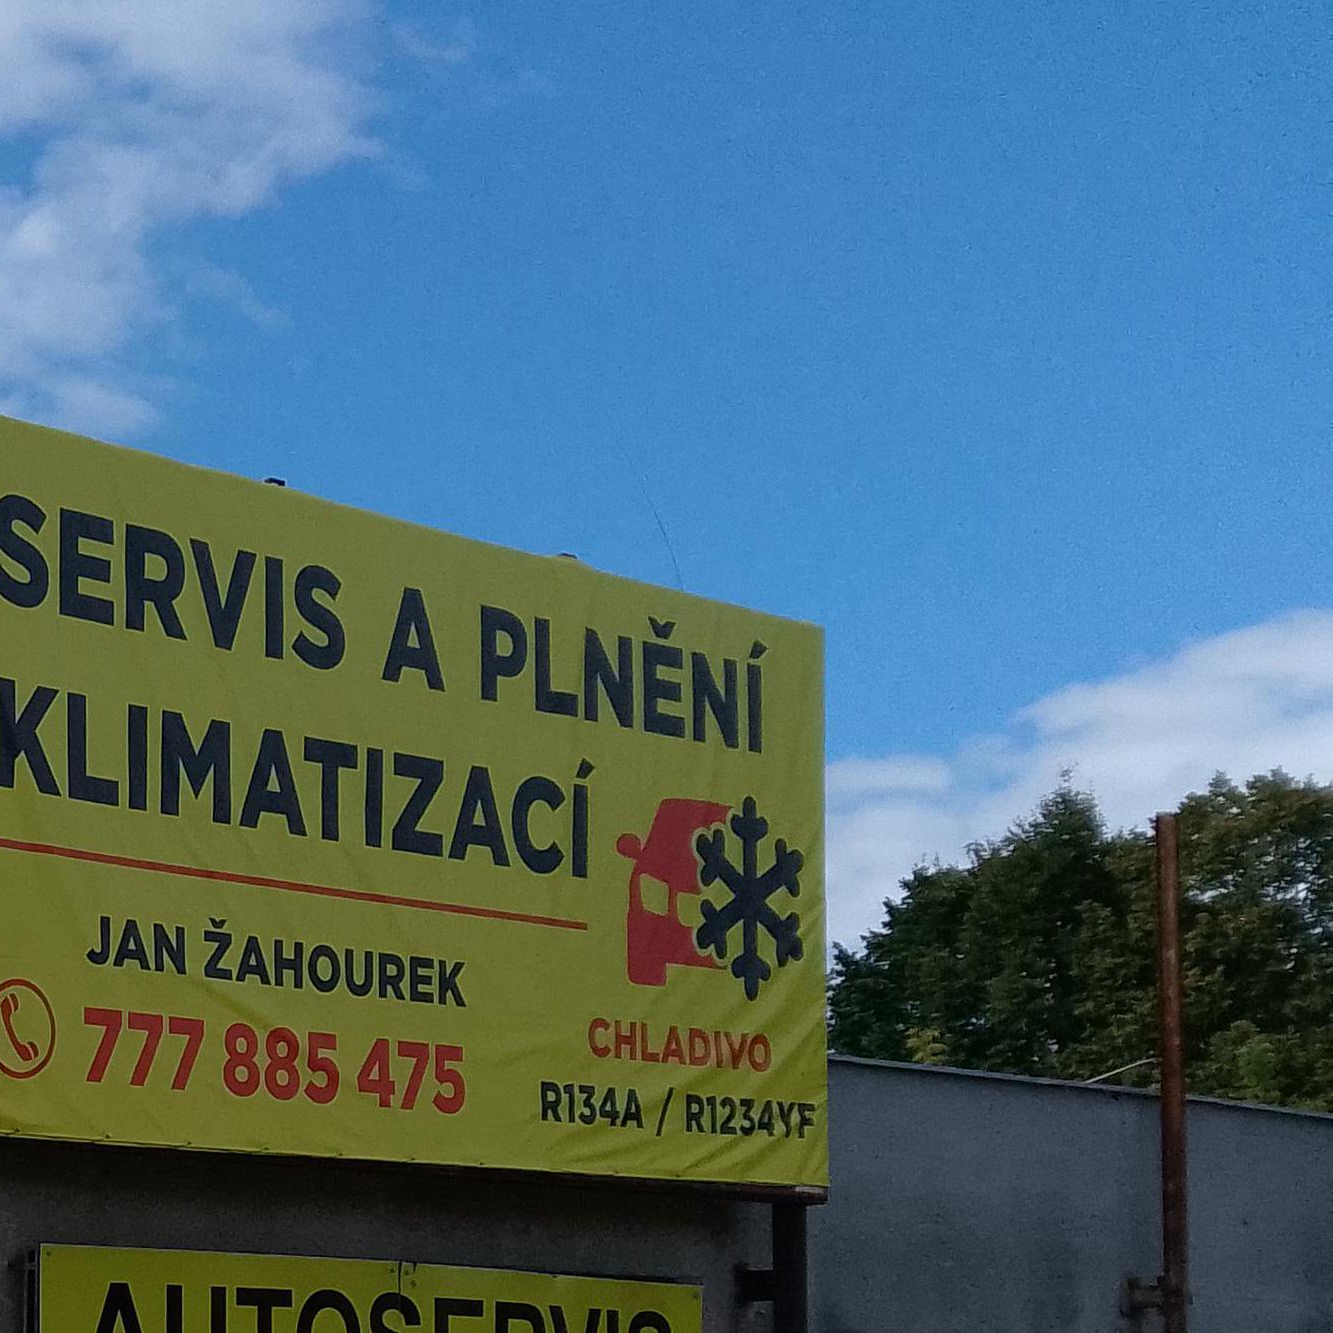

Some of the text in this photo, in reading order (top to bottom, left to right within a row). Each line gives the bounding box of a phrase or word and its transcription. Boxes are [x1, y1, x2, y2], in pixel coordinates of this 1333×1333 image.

[383, 588, 445, 692] A
[480, 602, 768, 753] PLNĚNÍ
[86, 914, 467, 1007] JAN ŽAHOUREK
[82, 1005, 466, 1115] 777 885 475
[587, 1016, 772, 1073] CHLADIVO
[539, 1080, 644, 1130] R134A
[684, 1093, 816, 1140] R1234YF
